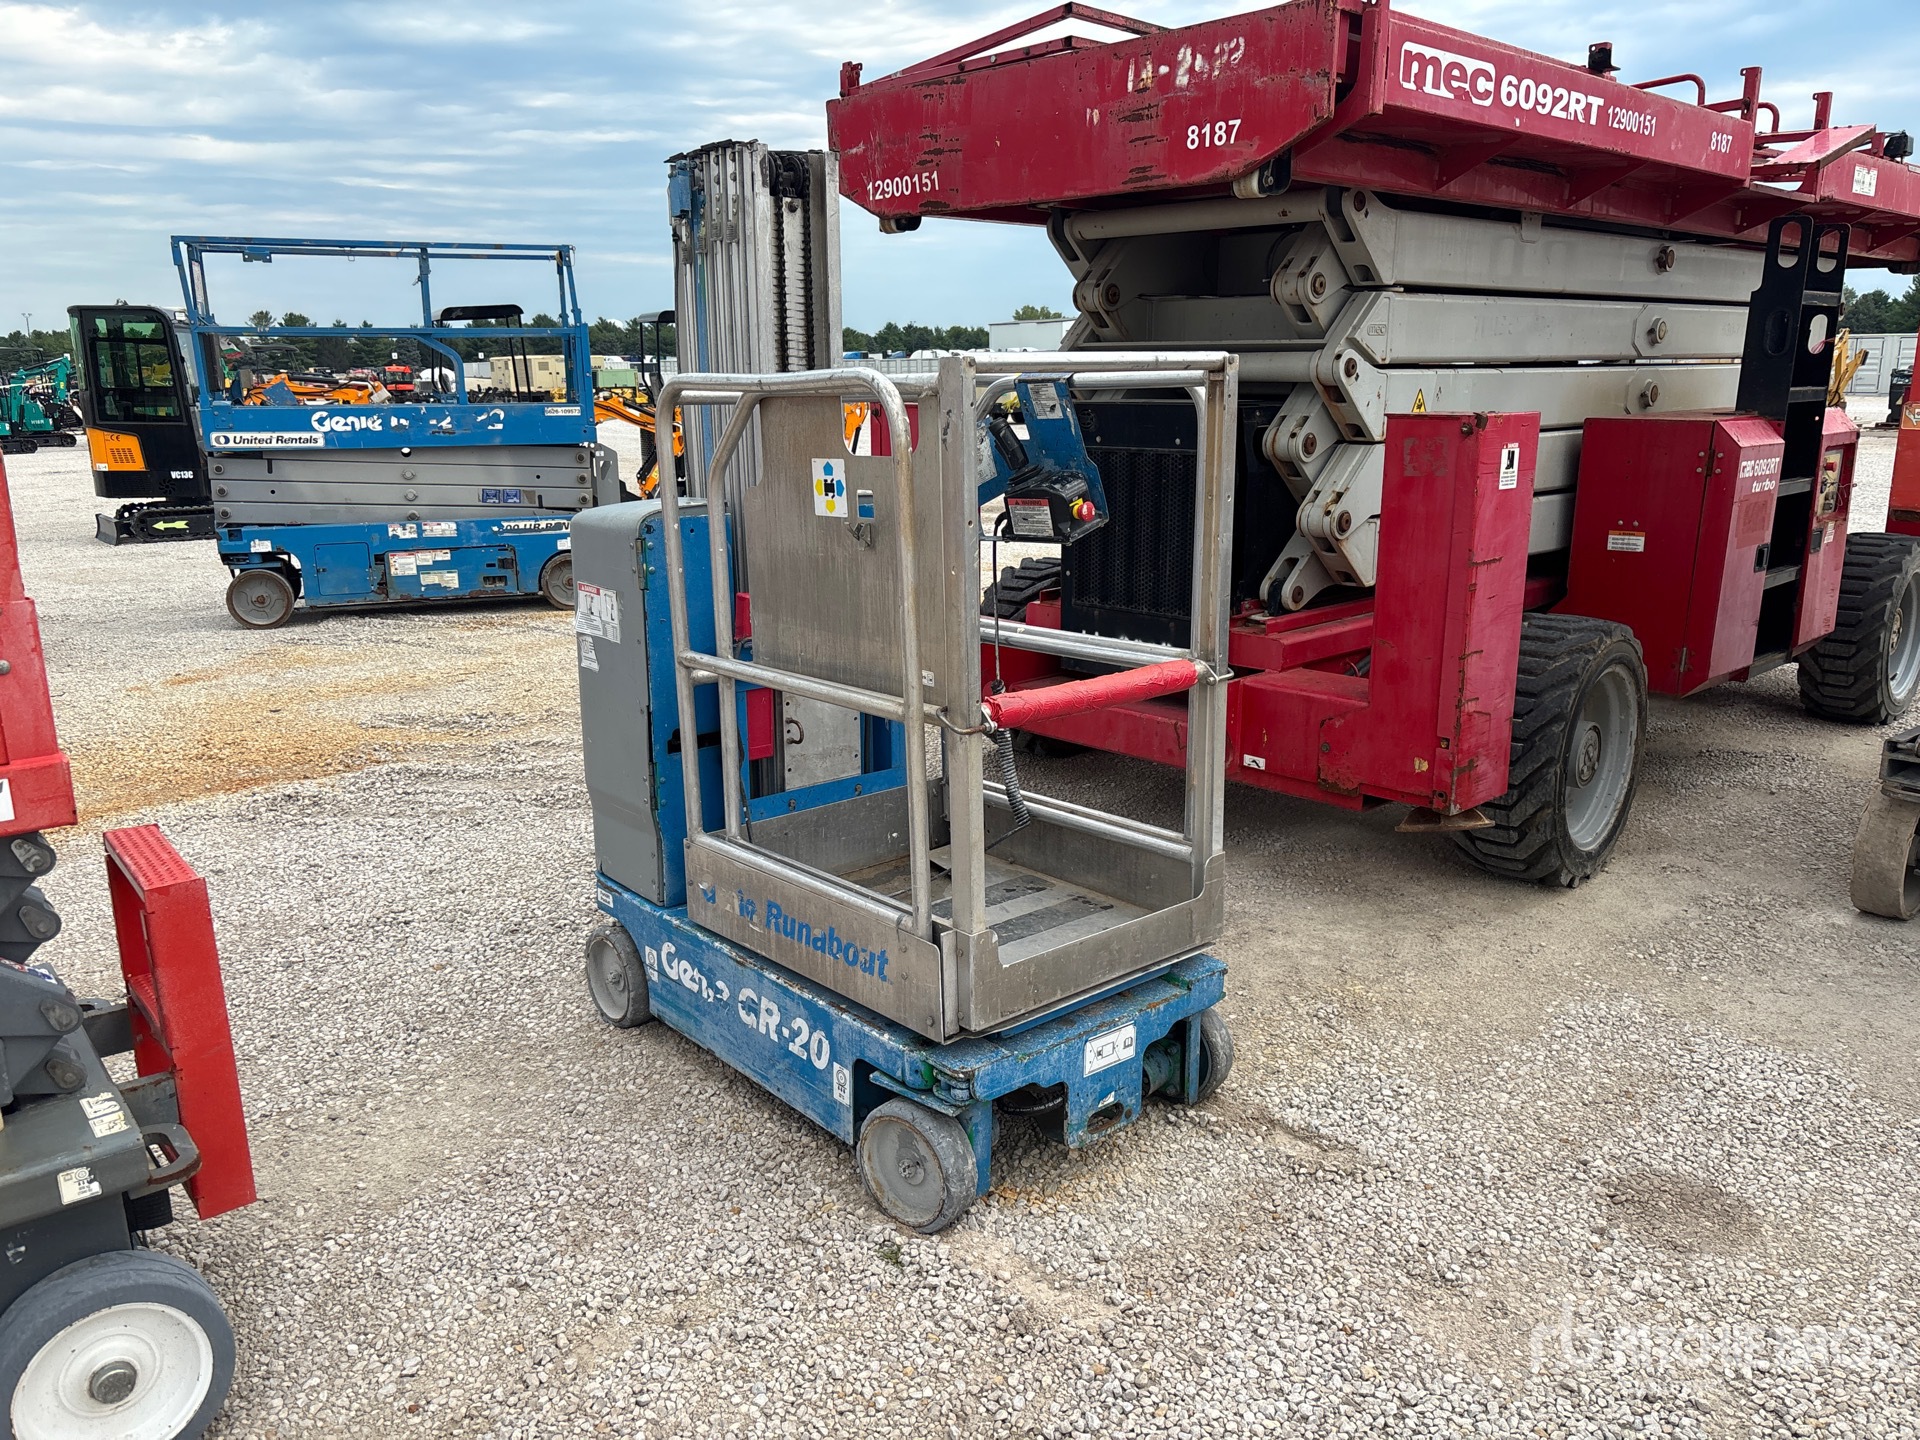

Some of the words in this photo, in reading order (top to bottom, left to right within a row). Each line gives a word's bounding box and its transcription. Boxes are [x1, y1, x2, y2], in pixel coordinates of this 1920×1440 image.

[1401, 43, 1495, 105] mec
[1500, 75, 1605, 126] 6092RT
[1607, 106, 1656, 137] 12900151
[1186, 118, 1243, 150] 8187
[1710, 131, 1732, 153] 8187
[867, 171, 939, 201] 12900151
[311, 411, 383, 432] Genie
[233, 435, 273, 445] United
[276, 435, 319, 445] Rentals
[170, 470, 194, 479] VC13C
[1754, 457, 1780, 476] 6092RT
[1752, 478, 1775, 493] turbo
[765, 899, 889, 982] Runabout
[738, 988, 830, 1070] GR-20
